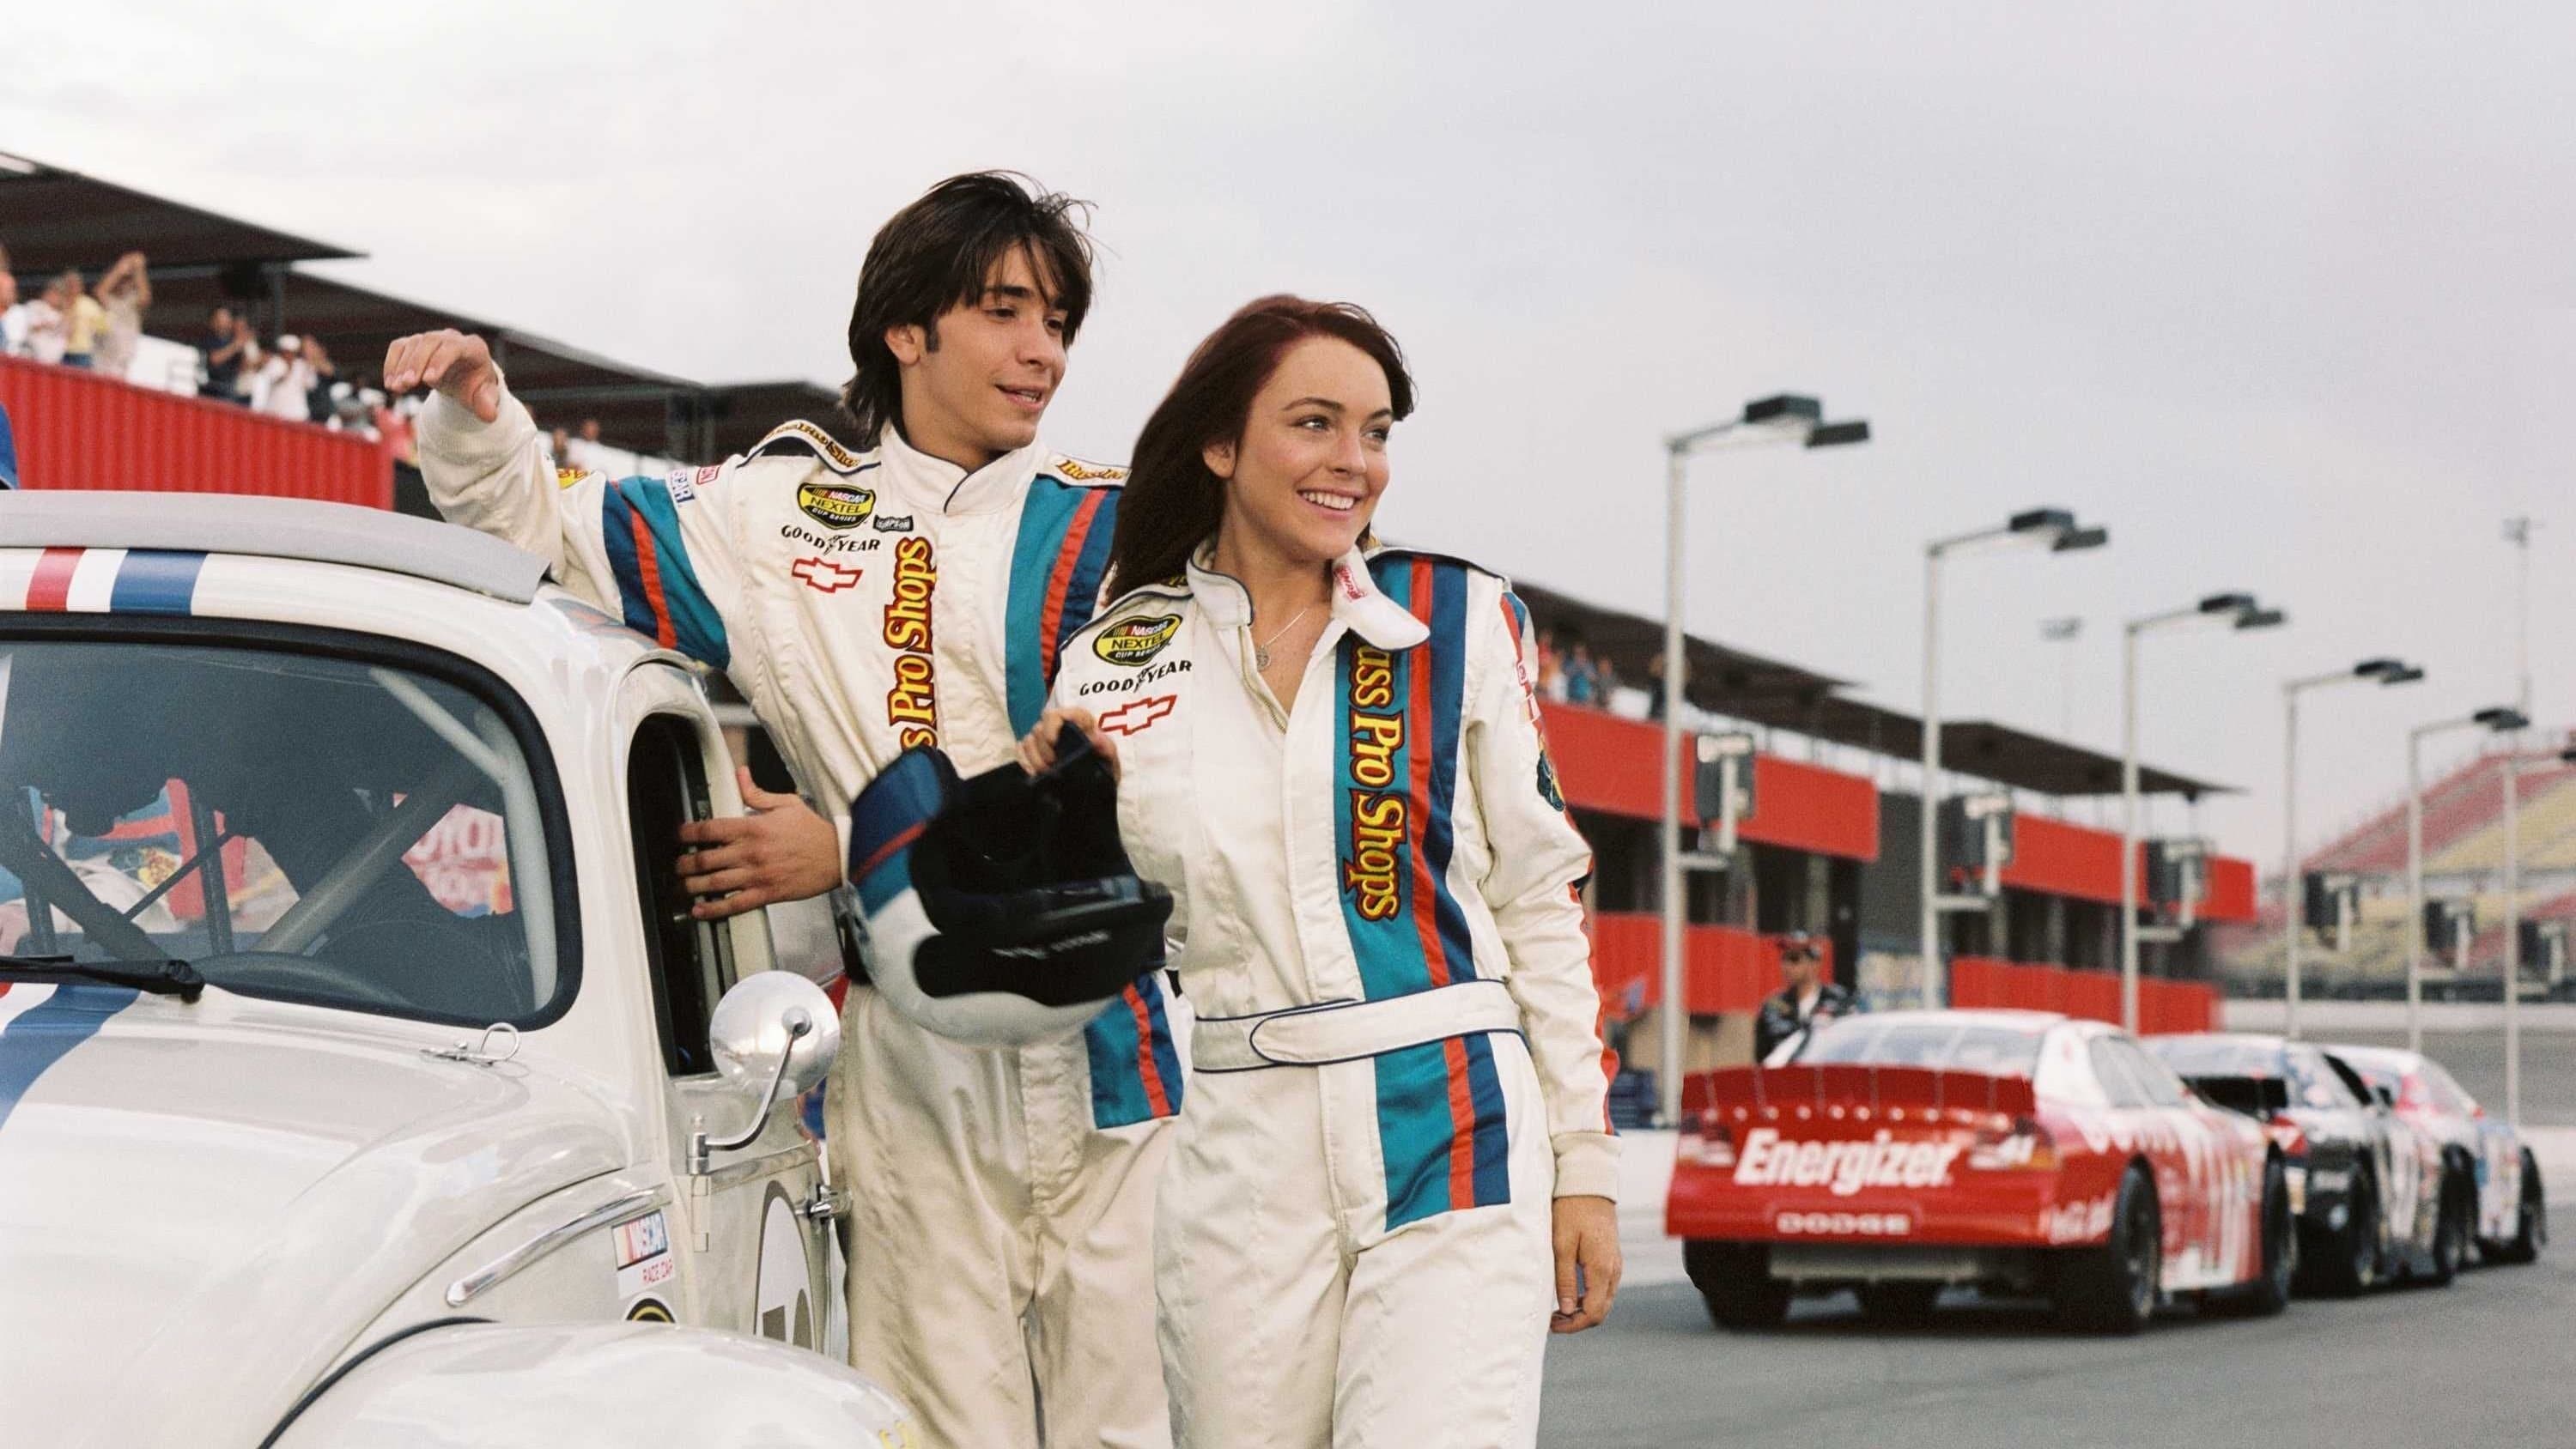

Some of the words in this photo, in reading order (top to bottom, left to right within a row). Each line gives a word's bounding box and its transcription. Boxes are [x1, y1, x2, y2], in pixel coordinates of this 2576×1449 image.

[810, 496, 862, 513] NEXTEL
[829, 488, 866, 503] NASCAR
[811, 507, 829, 518] CUP
[829, 511, 857, 522] SERIES
[884, 537, 937, 654] Shops
[1131, 620, 1169, 636] NASCAR
[1111, 633, 1166, 650] NEXTEL
[1115, 648, 1132, 658] CUP
[1349, 645, 1394, 709] ass
[884, 654, 937, 731] Pro
[1348, 705, 1405, 787] Pro
[1344, 788, 1407, 922] Shops
[1734, 1127, 1960, 1197] Energizer
[1776, 1212, 1911, 1235] DODGE
